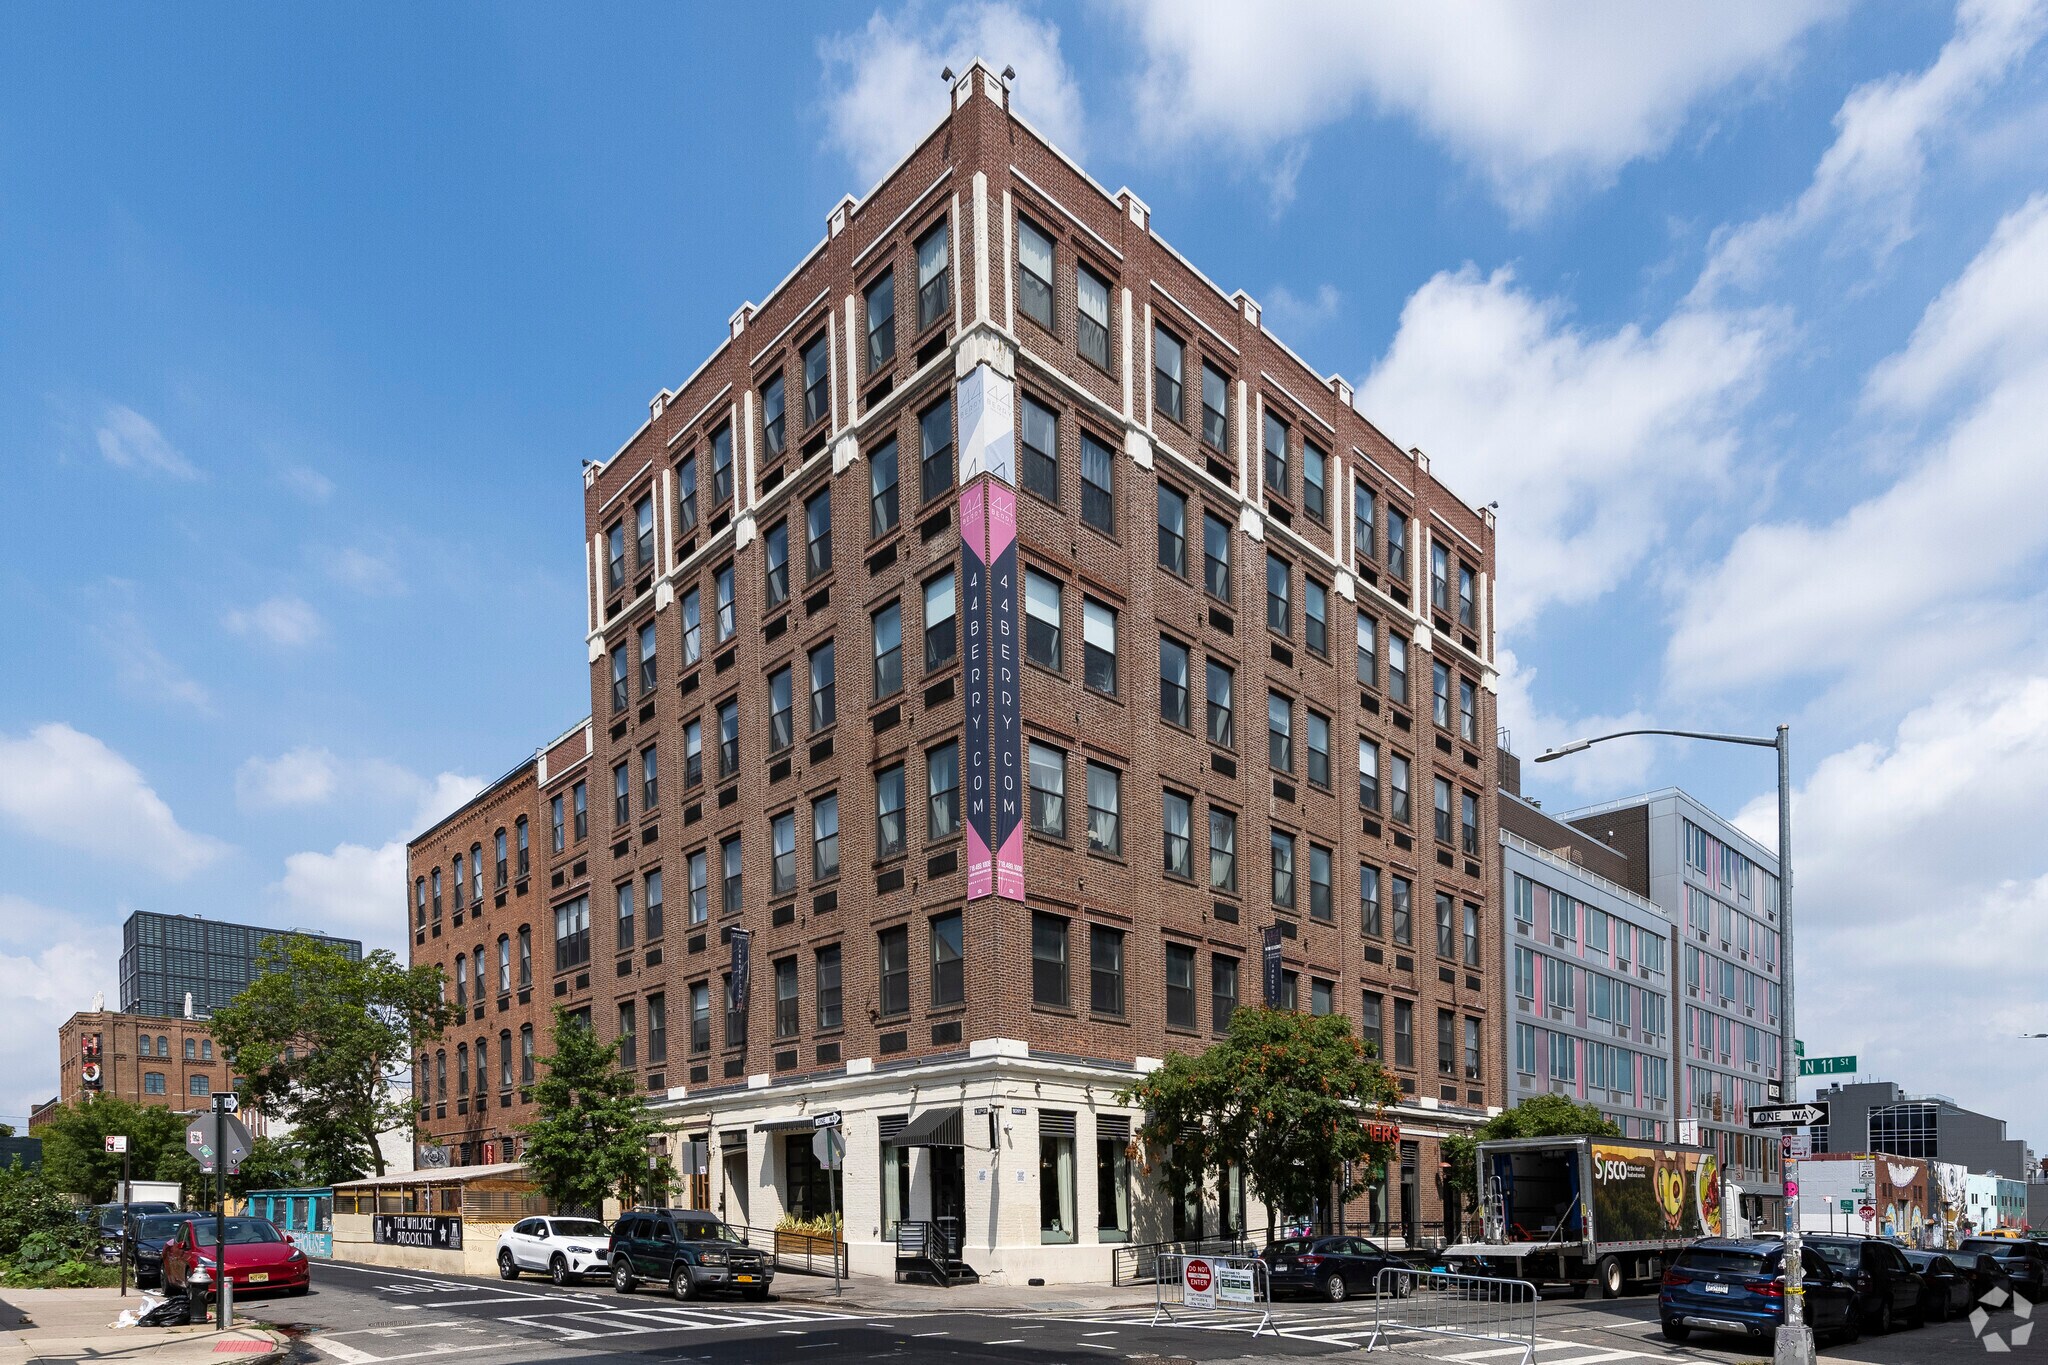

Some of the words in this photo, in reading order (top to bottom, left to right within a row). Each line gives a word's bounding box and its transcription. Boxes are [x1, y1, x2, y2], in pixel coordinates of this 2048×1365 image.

[1805, 1061, 1814, 1074] N
[1821, 1059, 1833, 1073] 11
[1841, 1058, 1849, 1066] St
[1759, 1112, 1782, 1122] ONE
[1792, 1110, 1816, 1120] WAY
[394, 1217, 406, 1229] THE
[407, 1217, 436, 1230] WHISKEY
[397, 1232, 432, 1246] BROOKLYN
